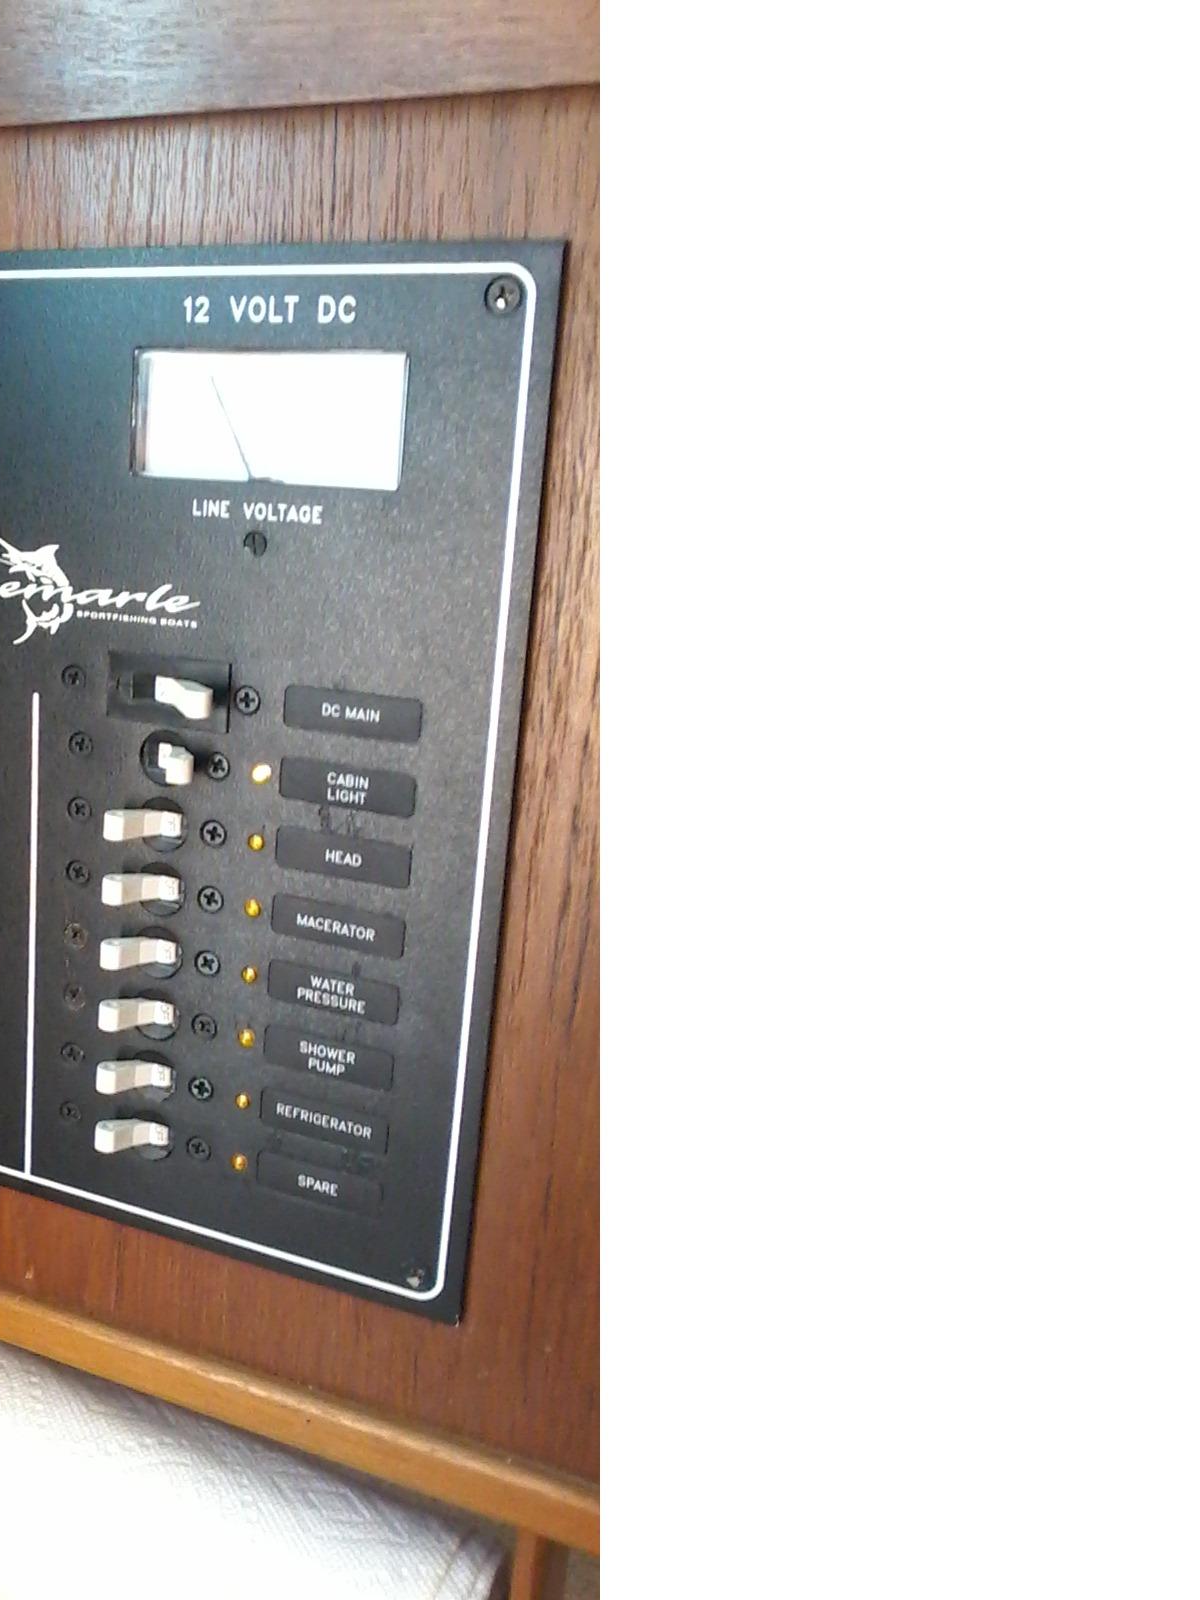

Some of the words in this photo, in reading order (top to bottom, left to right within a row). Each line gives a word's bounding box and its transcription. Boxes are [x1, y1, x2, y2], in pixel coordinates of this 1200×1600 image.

[183, 295, 210, 324] 12
[229, 294, 300, 324] VOLT
[317, 294, 357, 324] DC
[192, 498, 231, 519] LINE
[243, 502, 324, 525] VOLTAGE
[76, 609, 158, 626] SPORTFISHING
[160, 617, 198, 629] BOATS
[321, 702, 341, 718] DC
[345, 705, 381, 723] MAIN
[326, 771, 369, 789] CABIN
[327, 787, 368, 805] LIGHT
[325, 848, 362, 867] HEAD
[296, 913, 376, 942] MACERATOR
[310, 975, 356, 996] WATER
[296, 986, 366, 1015] PRESSURE
[299, 1040, 356, 1066] SHOWER
[307, 1056, 347, 1077] PUMP
[276, 1102, 373, 1140] REFRIGERATOR
[297, 1174, 339, 1197] SPARE
